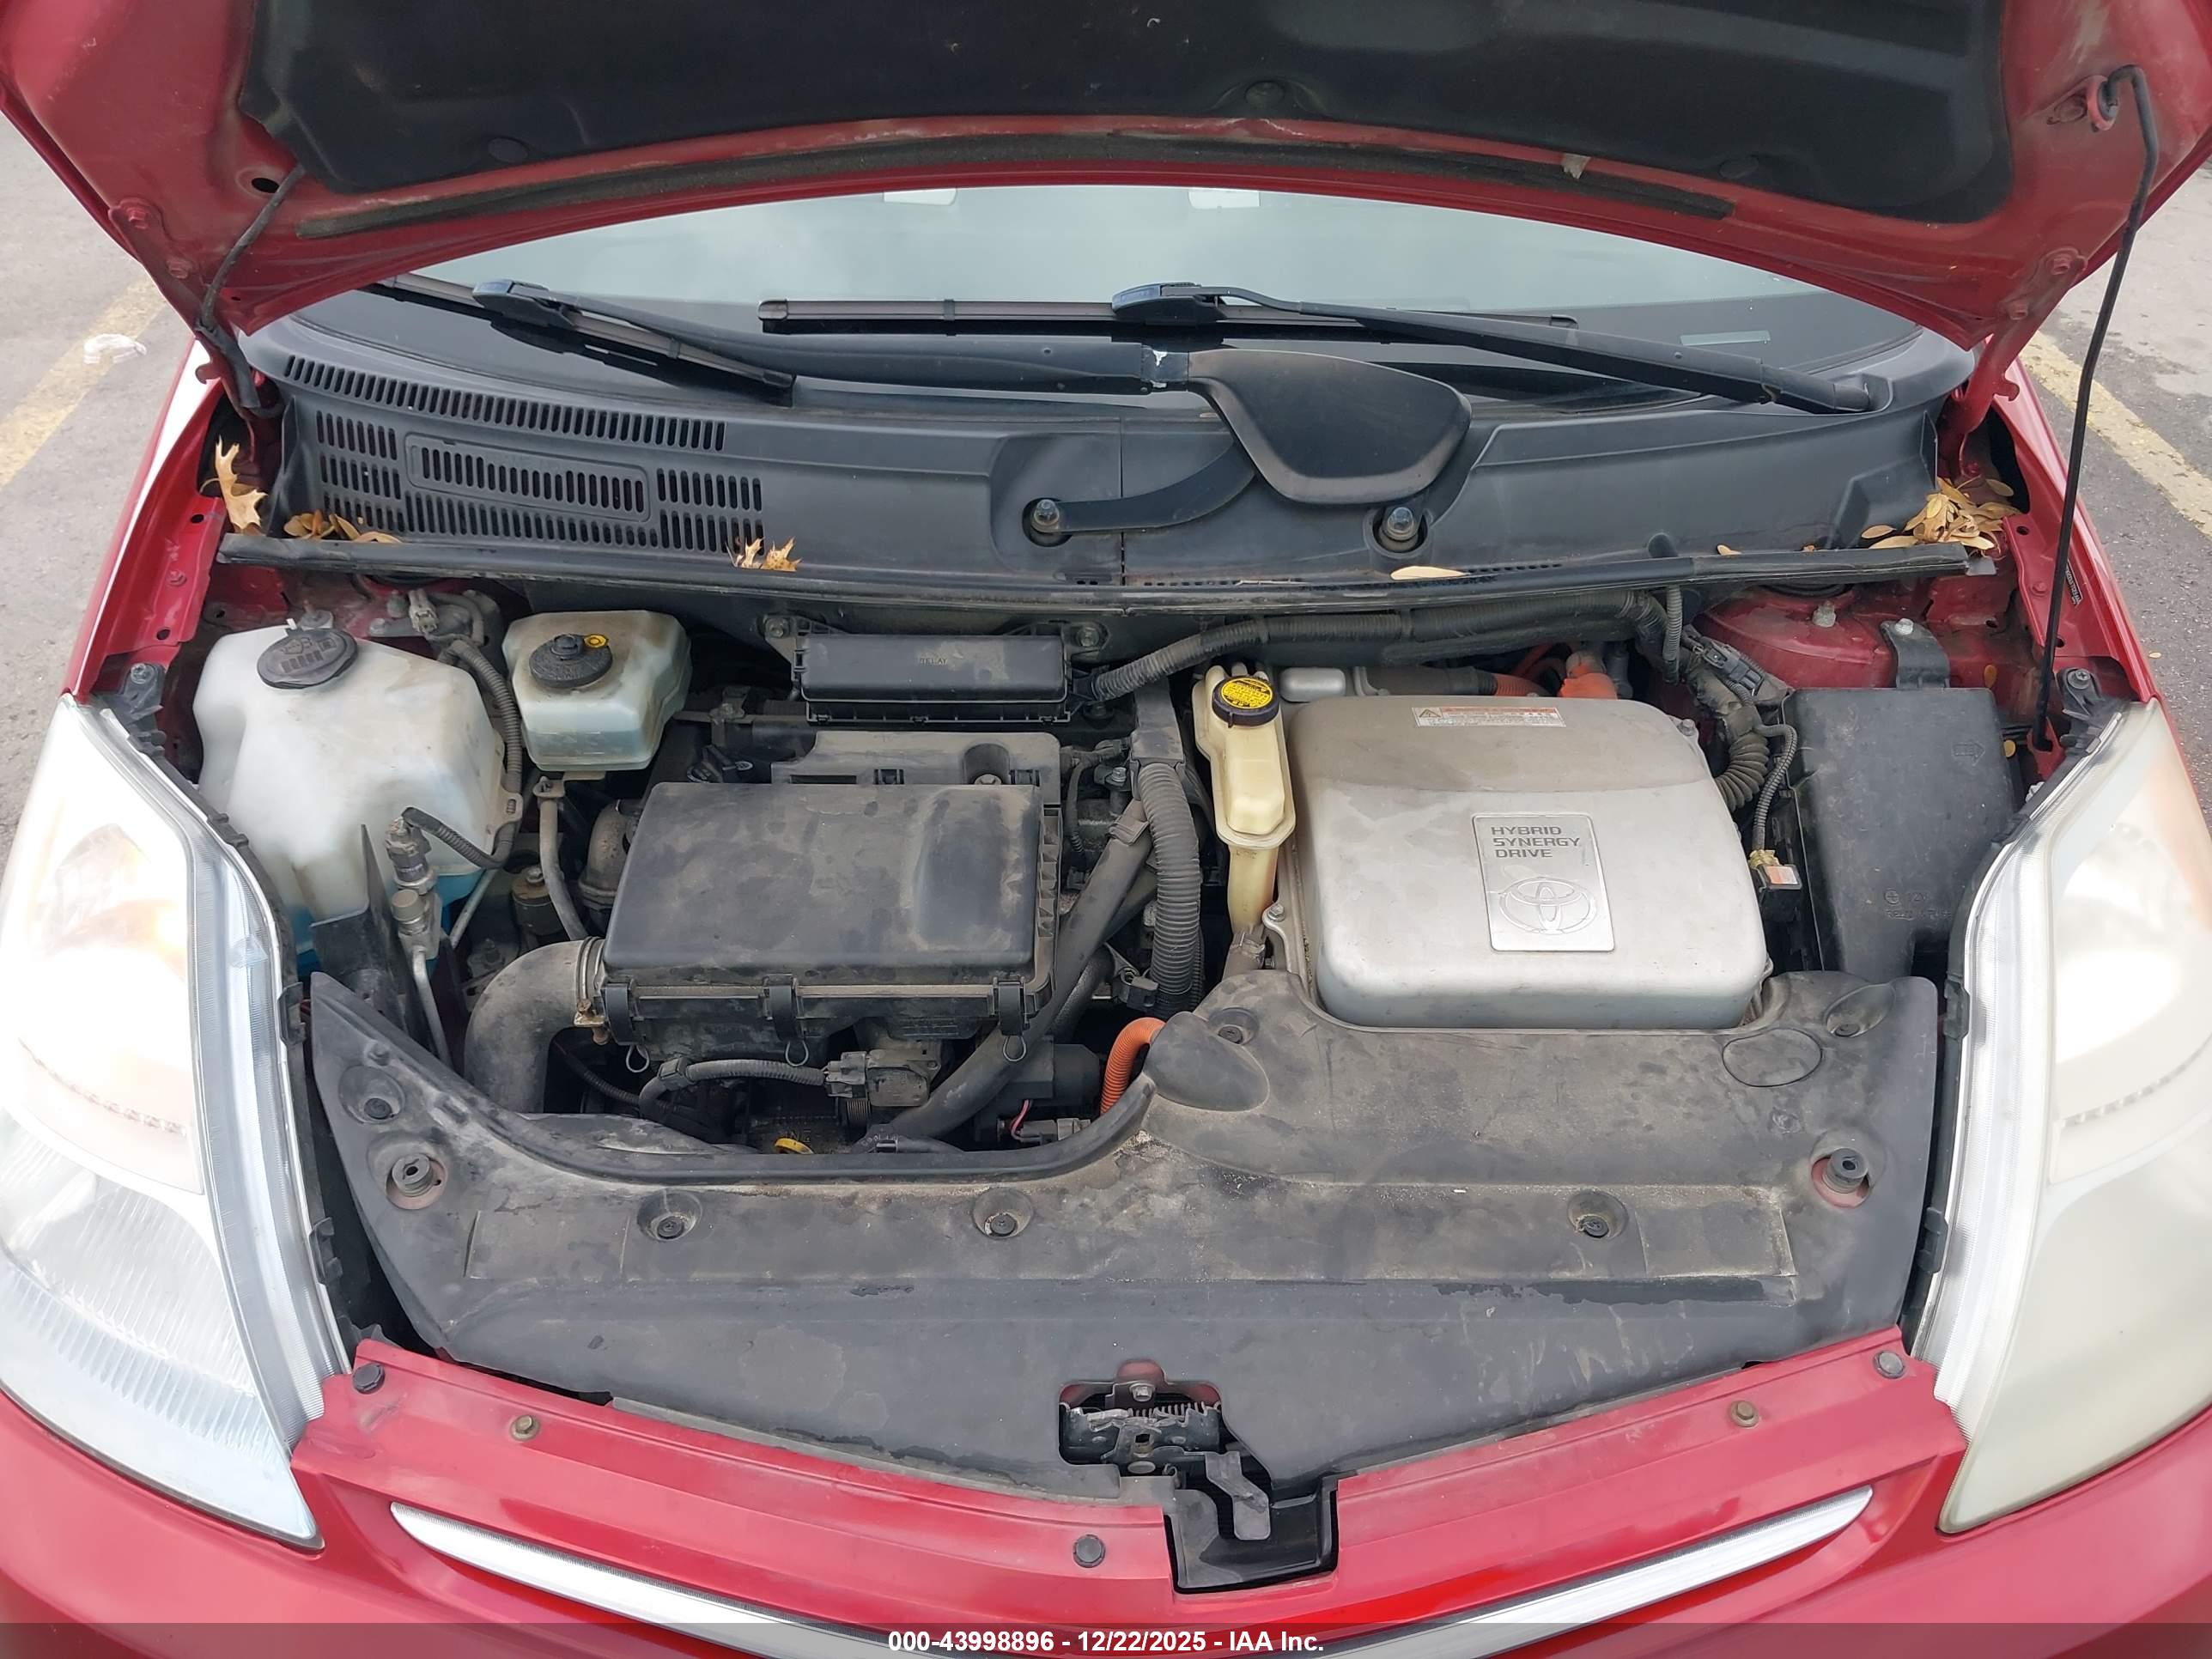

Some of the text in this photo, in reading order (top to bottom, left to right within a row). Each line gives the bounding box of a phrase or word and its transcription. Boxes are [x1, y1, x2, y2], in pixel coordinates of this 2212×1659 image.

[1491, 826, 1562, 836] HYBRID
[1493, 837, 1580, 847] SYNERGY
[1495, 848, 1553, 858] DRIVE
